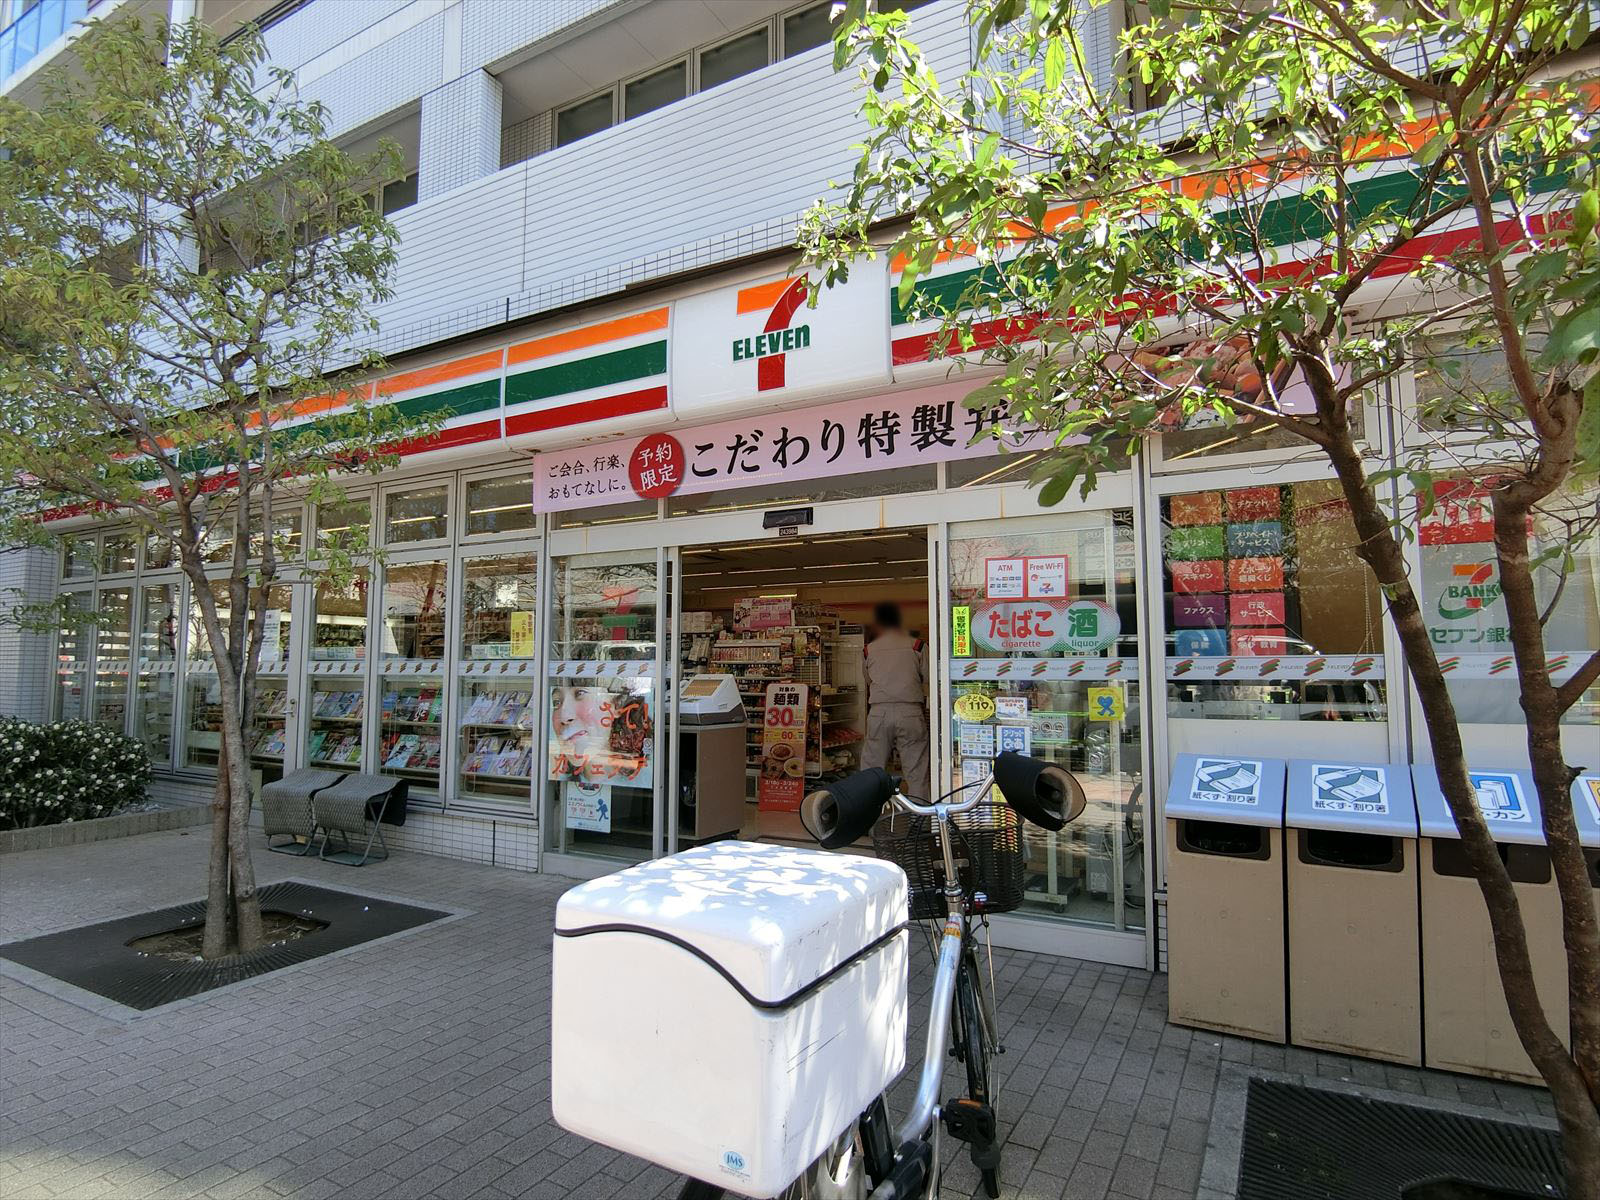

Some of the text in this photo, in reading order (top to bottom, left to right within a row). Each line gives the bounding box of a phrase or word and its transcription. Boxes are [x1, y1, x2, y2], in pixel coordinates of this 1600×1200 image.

[737, 272, 809, 392] 7
[548, 453, 626, 478] ご会合、行楽、
[637, 442, 673, 468] 予約
[640, 463, 678, 491] 限定
[548, 478, 627, 500] おもてなしに。
[997, 564, 1013, 572] ATM
[1029, 562, 1064, 571] Free Wi-Fi
[1449, 584, 1498, 598] BANK
[1183, 606, 1215, 615] ファクス
[988, 609, 1055, 639] たばこ
[1068, 608, 1099, 638] 酒
[1001, 639, 1100, 649] cigarette liquor
[767, 706, 794, 727] 30
[1314, 800, 1387, 814] 紙くず・割り箸
